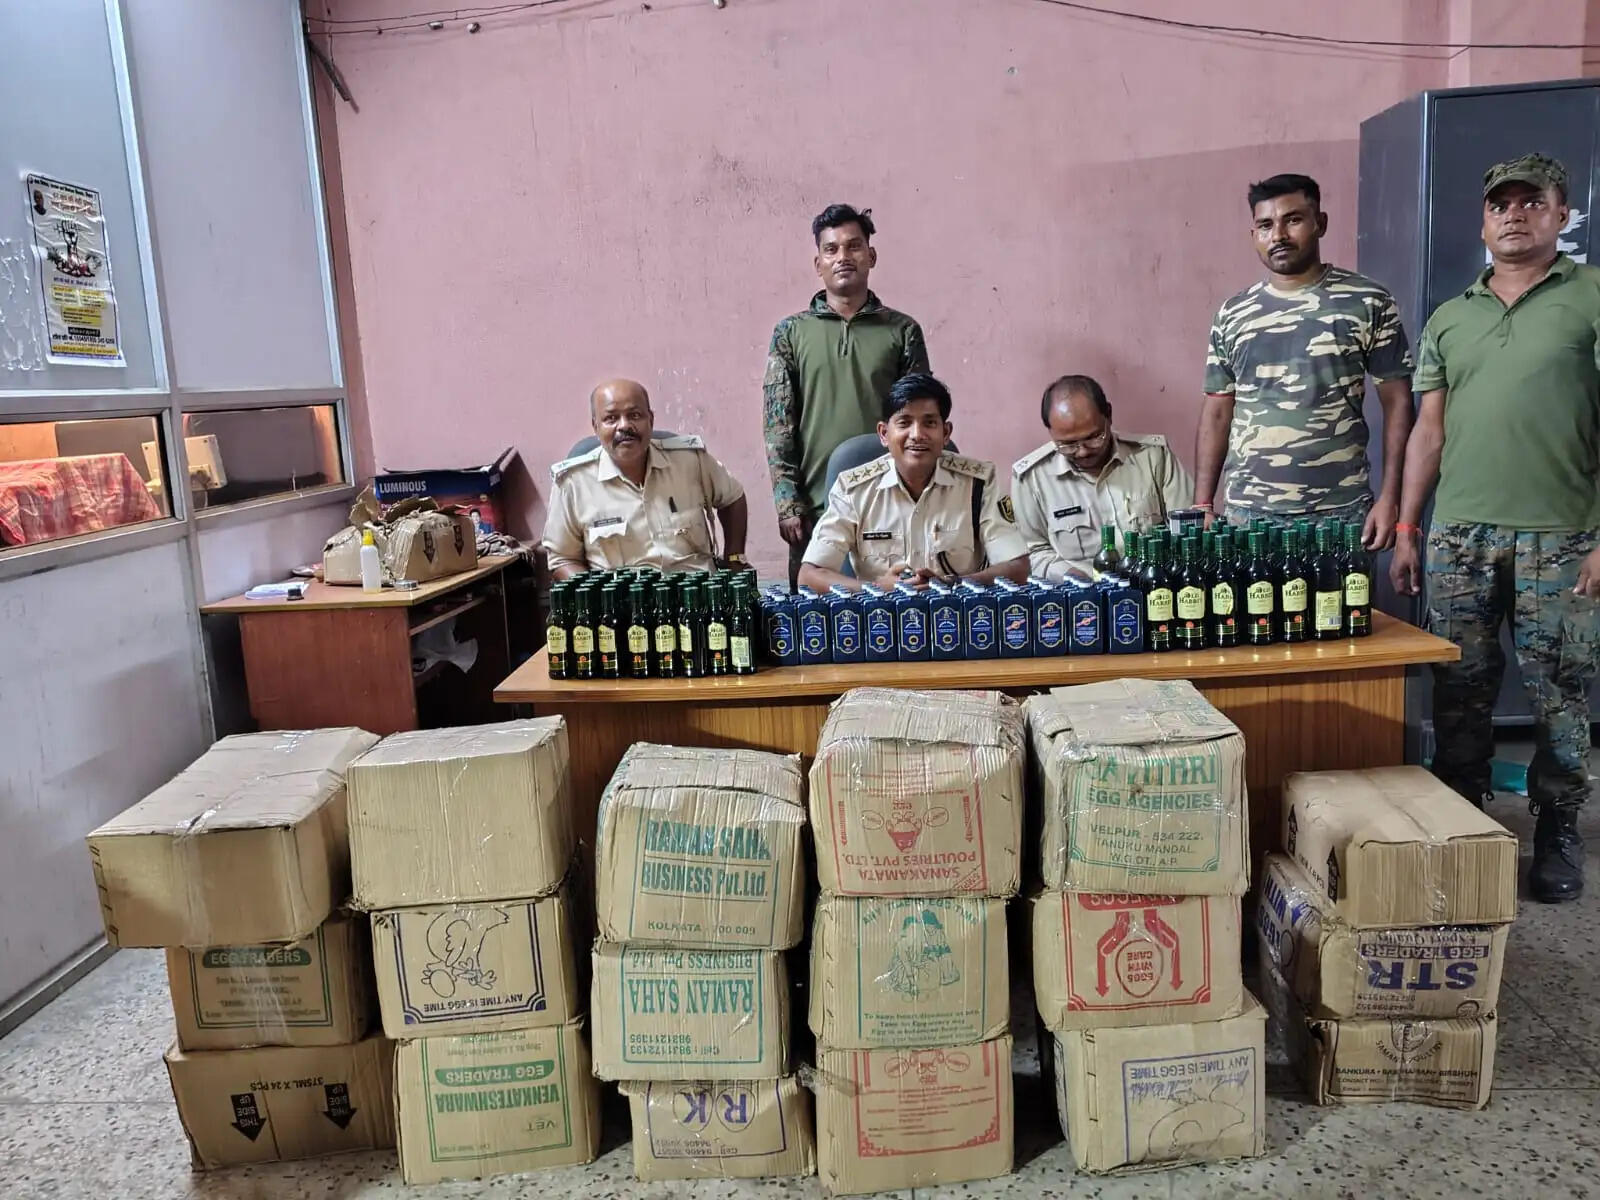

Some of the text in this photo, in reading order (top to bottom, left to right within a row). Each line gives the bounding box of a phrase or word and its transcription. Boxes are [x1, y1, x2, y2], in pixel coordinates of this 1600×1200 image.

[379, 480, 427, 494] LUMINOUS
[1089, 787, 1213, 810] EGG AGENCIES
[645, 820, 715, 857] RAMAN
[1091, 824, 1140, 839] VELPUR
[1097, 838, 1142, 852] TANUKU
[903, 851, 976, 866] POULTRIES
[642, 861, 712, 894] BUSINESS
[859, 867, 960, 880] SANAKAMATA
[211, 951, 302, 965] EGG TRADERS
[1127, 951, 1153, 961] CARE
[1366, 945, 1485, 959] EGG TRADERS
[688, 953, 752, 969] BUSINESS
[1128, 961, 1153, 971] WITH
[1127, 972, 1154, 983] EGGS
[1368, 960, 1479, 990] STR
[480, 996, 501, 1007] TIME
[504, 994, 523, 1004] ANY
[628, 980, 754, 1014] RAMAN SAHA
[424, 1002, 446, 1012] TIME
[446, 1065, 544, 1083] EGG TRADERS
[1130, 1055, 1249, 1079] ANY TIME IS EGG TIME
[250, 1082, 269, 1091] PCS
[271, 1081, 282, 1090] 24
[294, 1077, 324, 1089] 375ML
[240, 1095, 251, 1105] UP
[435, 1083, 561, 1113] VENKATESHWARA
[236, 1106, 256, 1116] SIDE
[680, 1092, 748, 1124] R K
[240, 1119, 259, 1128] THIS
[526, 1119, 555, 1132] VET
